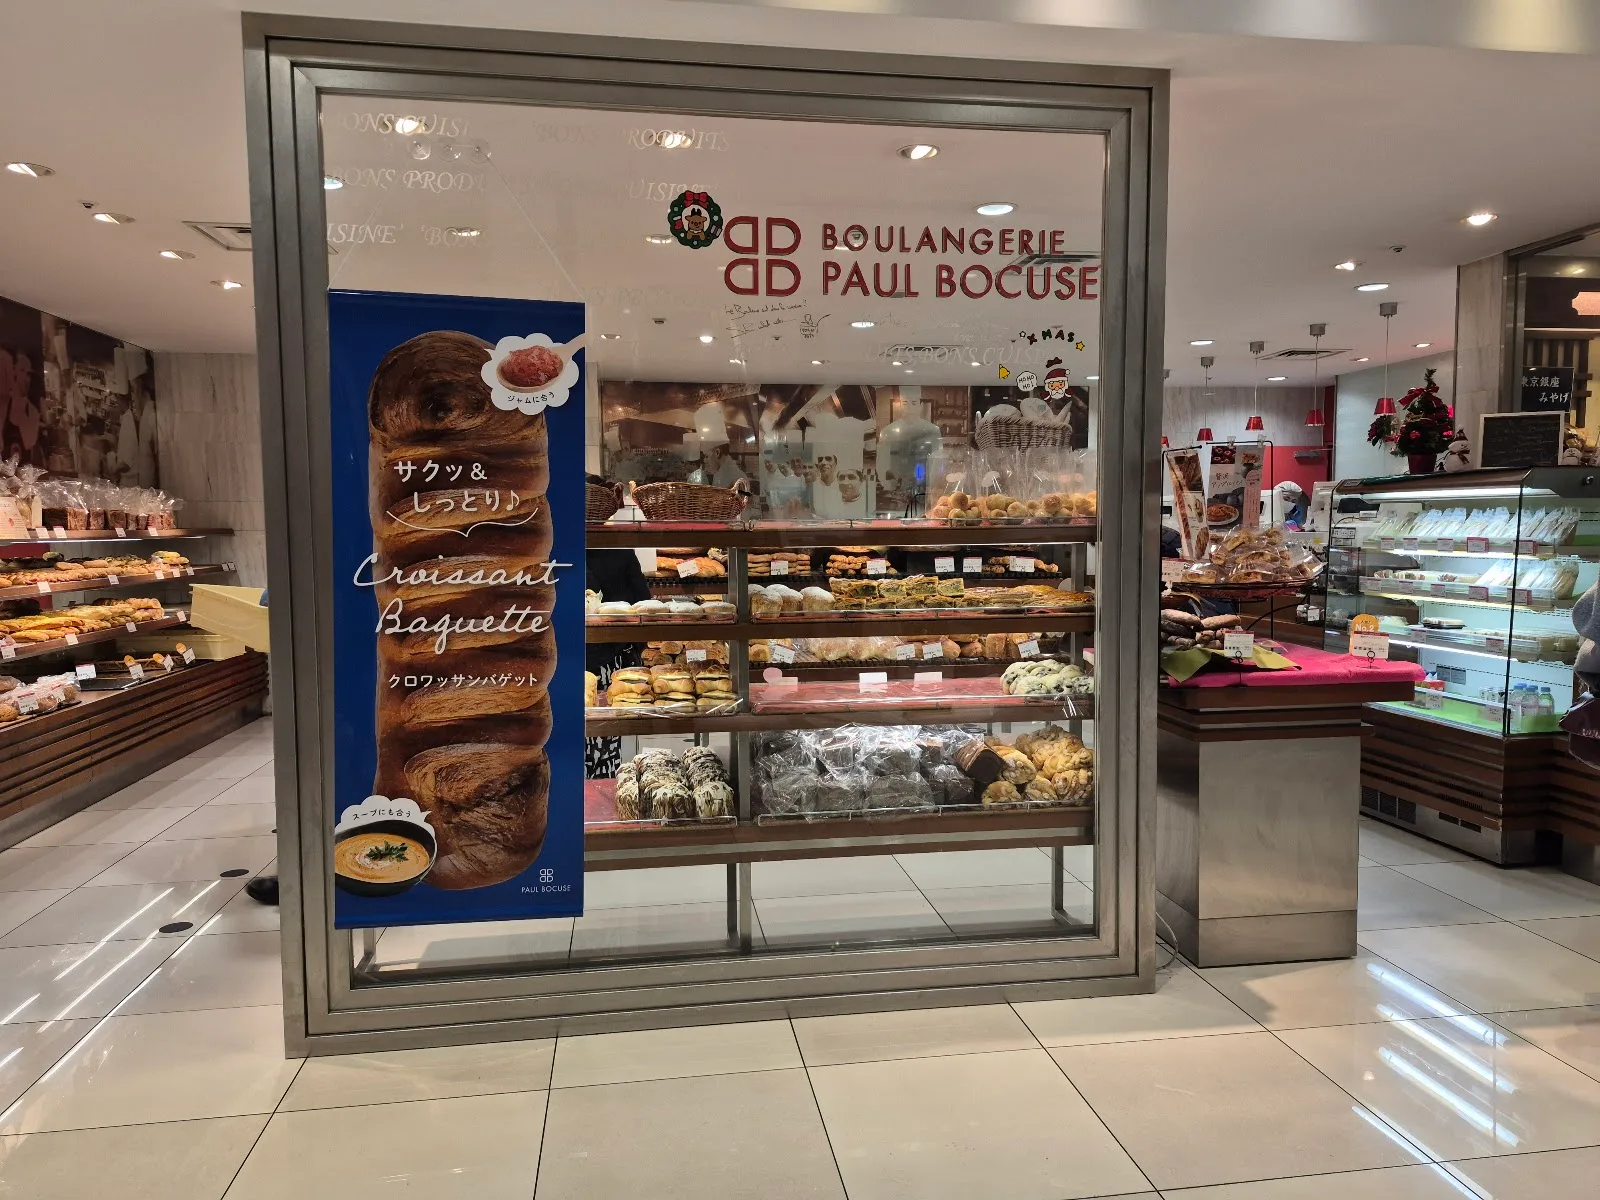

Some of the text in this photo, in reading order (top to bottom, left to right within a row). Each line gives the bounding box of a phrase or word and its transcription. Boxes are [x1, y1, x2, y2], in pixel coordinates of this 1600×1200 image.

[822, 222, 1066, 256] BOULANGERIE
[822, 259, 1099, 300] PAUL BOCUSE
[507, 391, 555, 404] ジャムに合う
[1539, 391, 1570, 403] みやげ
[353, 552, 574, 587] Croissant
[375, 597, 551, 655] Baguette
[1355, 623, 1375, 632] No.2
[388, 672, 539, 689] クロワッサンバゲット
[352, 808, 411, 821] スープにも合う
[541, 884, 571, 893] BOCUSE
